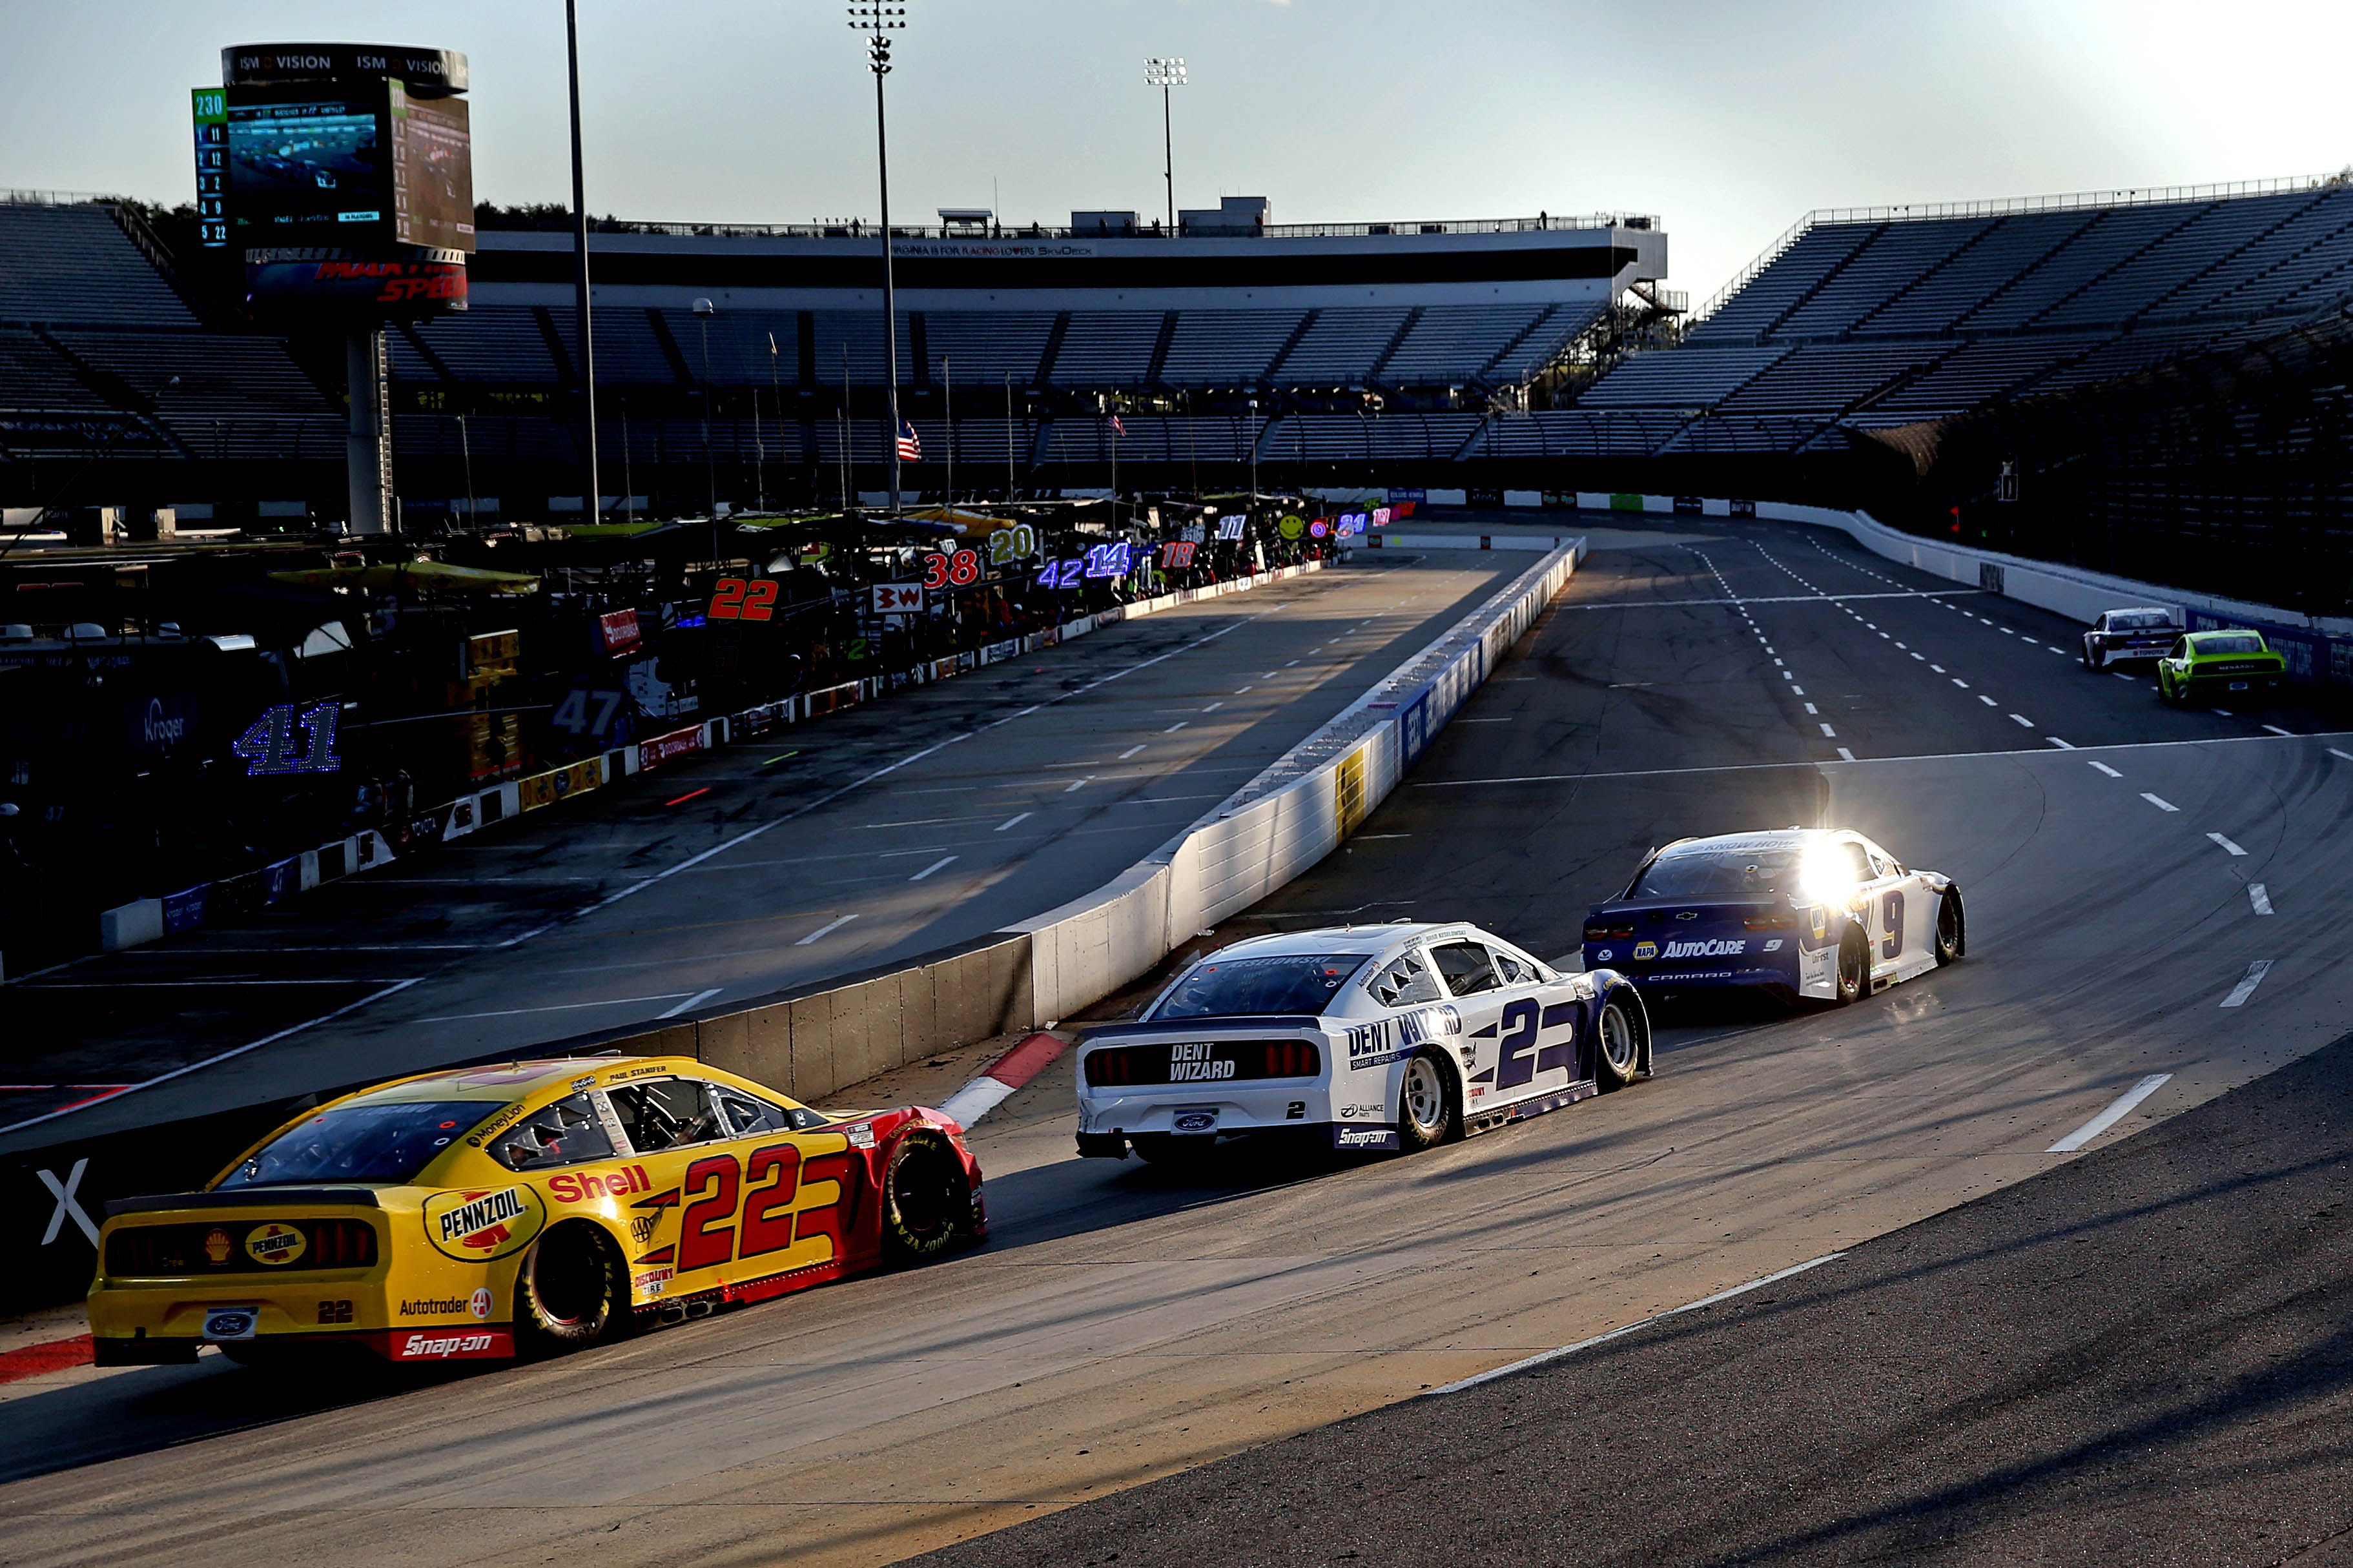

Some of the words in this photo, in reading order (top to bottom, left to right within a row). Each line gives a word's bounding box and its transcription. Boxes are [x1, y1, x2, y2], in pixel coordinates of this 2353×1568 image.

[240, 56, 260, 70] ISM
[276, 56, 331, 69] VISION
[357, 56, 385, 69] ISM
[407, 59, 449, 76] VISION
[196, 94, 223, 116] 230
[198, 127, 201, 142] 1
[211, 127, 220, 142] 11
[198, 153, 203, 167] 2
[212, 150, 221, 166] 12
[199, 175, 205, 191] 3
[214, 175, 220, 190] 2
[200, 200, 207, 215] 4
[215, 200, 221, 215] 9
[201, 225, 208, 239] 5
[215, 226, 226, 239] 22
[940, 246, 961, 256] FOR
[962, 246, 1000, 256] RACING
[1218, 514, 1247, 540] 11
[990, 524, 1034, 565] 20
[1084, 542, 1130, 578] 14
[1162, 542, 1197, 569] 18
[923, 549, 978, 589] 38
[1036, 559, 1084, 589] 42
[708, 578, 779, 621] 22
[144, 697, 185, 745] Kroger
[552, 687, 622, 737] 47
[232, 702, 341, 775] 41
[411, 817, 437, 837] TOYOTA
[1704, 841, 1752, 851] KNOW
[1881, 889, 1906, 962] 9
[1636, 945, 1656, 957] NAPA
[1763, 939, 1783, 952] 9
[1648, 972, 1732, 981] CAMARO
[1342, 1019, 1392, 1057] DENT
[1495, 997, 1541, 1091] 2
[1171, 1043, 1214, 1061] DENT
[1352, 1058, 1372, 1070] SMART
[1373, 1052, 1402, 1065] REPAIRS
[609, 1072, 630, 1082] PAUL
[630, 1065, 667, 1077] STANIFER
[1169, 1060, 1235, 1081] WIZARD
[1286, 1101, 1306, 1120] 2
[1359, 1104, 1384, 1112] ALLIANCE
[475, 1103, 527, 1141] MoneyLion
[889, 1118, 936, 1139] GOODYEA
[1182, 1118, 1206, 1127] Ford
[1339, 1127, 1388, 1147] Snap-on
[548, 1164, 652, 1203] Shell
[440, 1187, 525, 1243] PENNZOIL
[677, 1143, 801, 1274] 22
[252, 1232, 299, 1255] PENNZOIL
[635, 1267, 673, 1288] DISCOUNT
[643, 1283, 661, 1294] TIRE
[317, 1299, 353, 1324] 22
[400, 1298, 468, 1316] Autotrader
[215, 1316, 243, 1330] Ford
[402, 1334, 492, 1357] Snap-on
